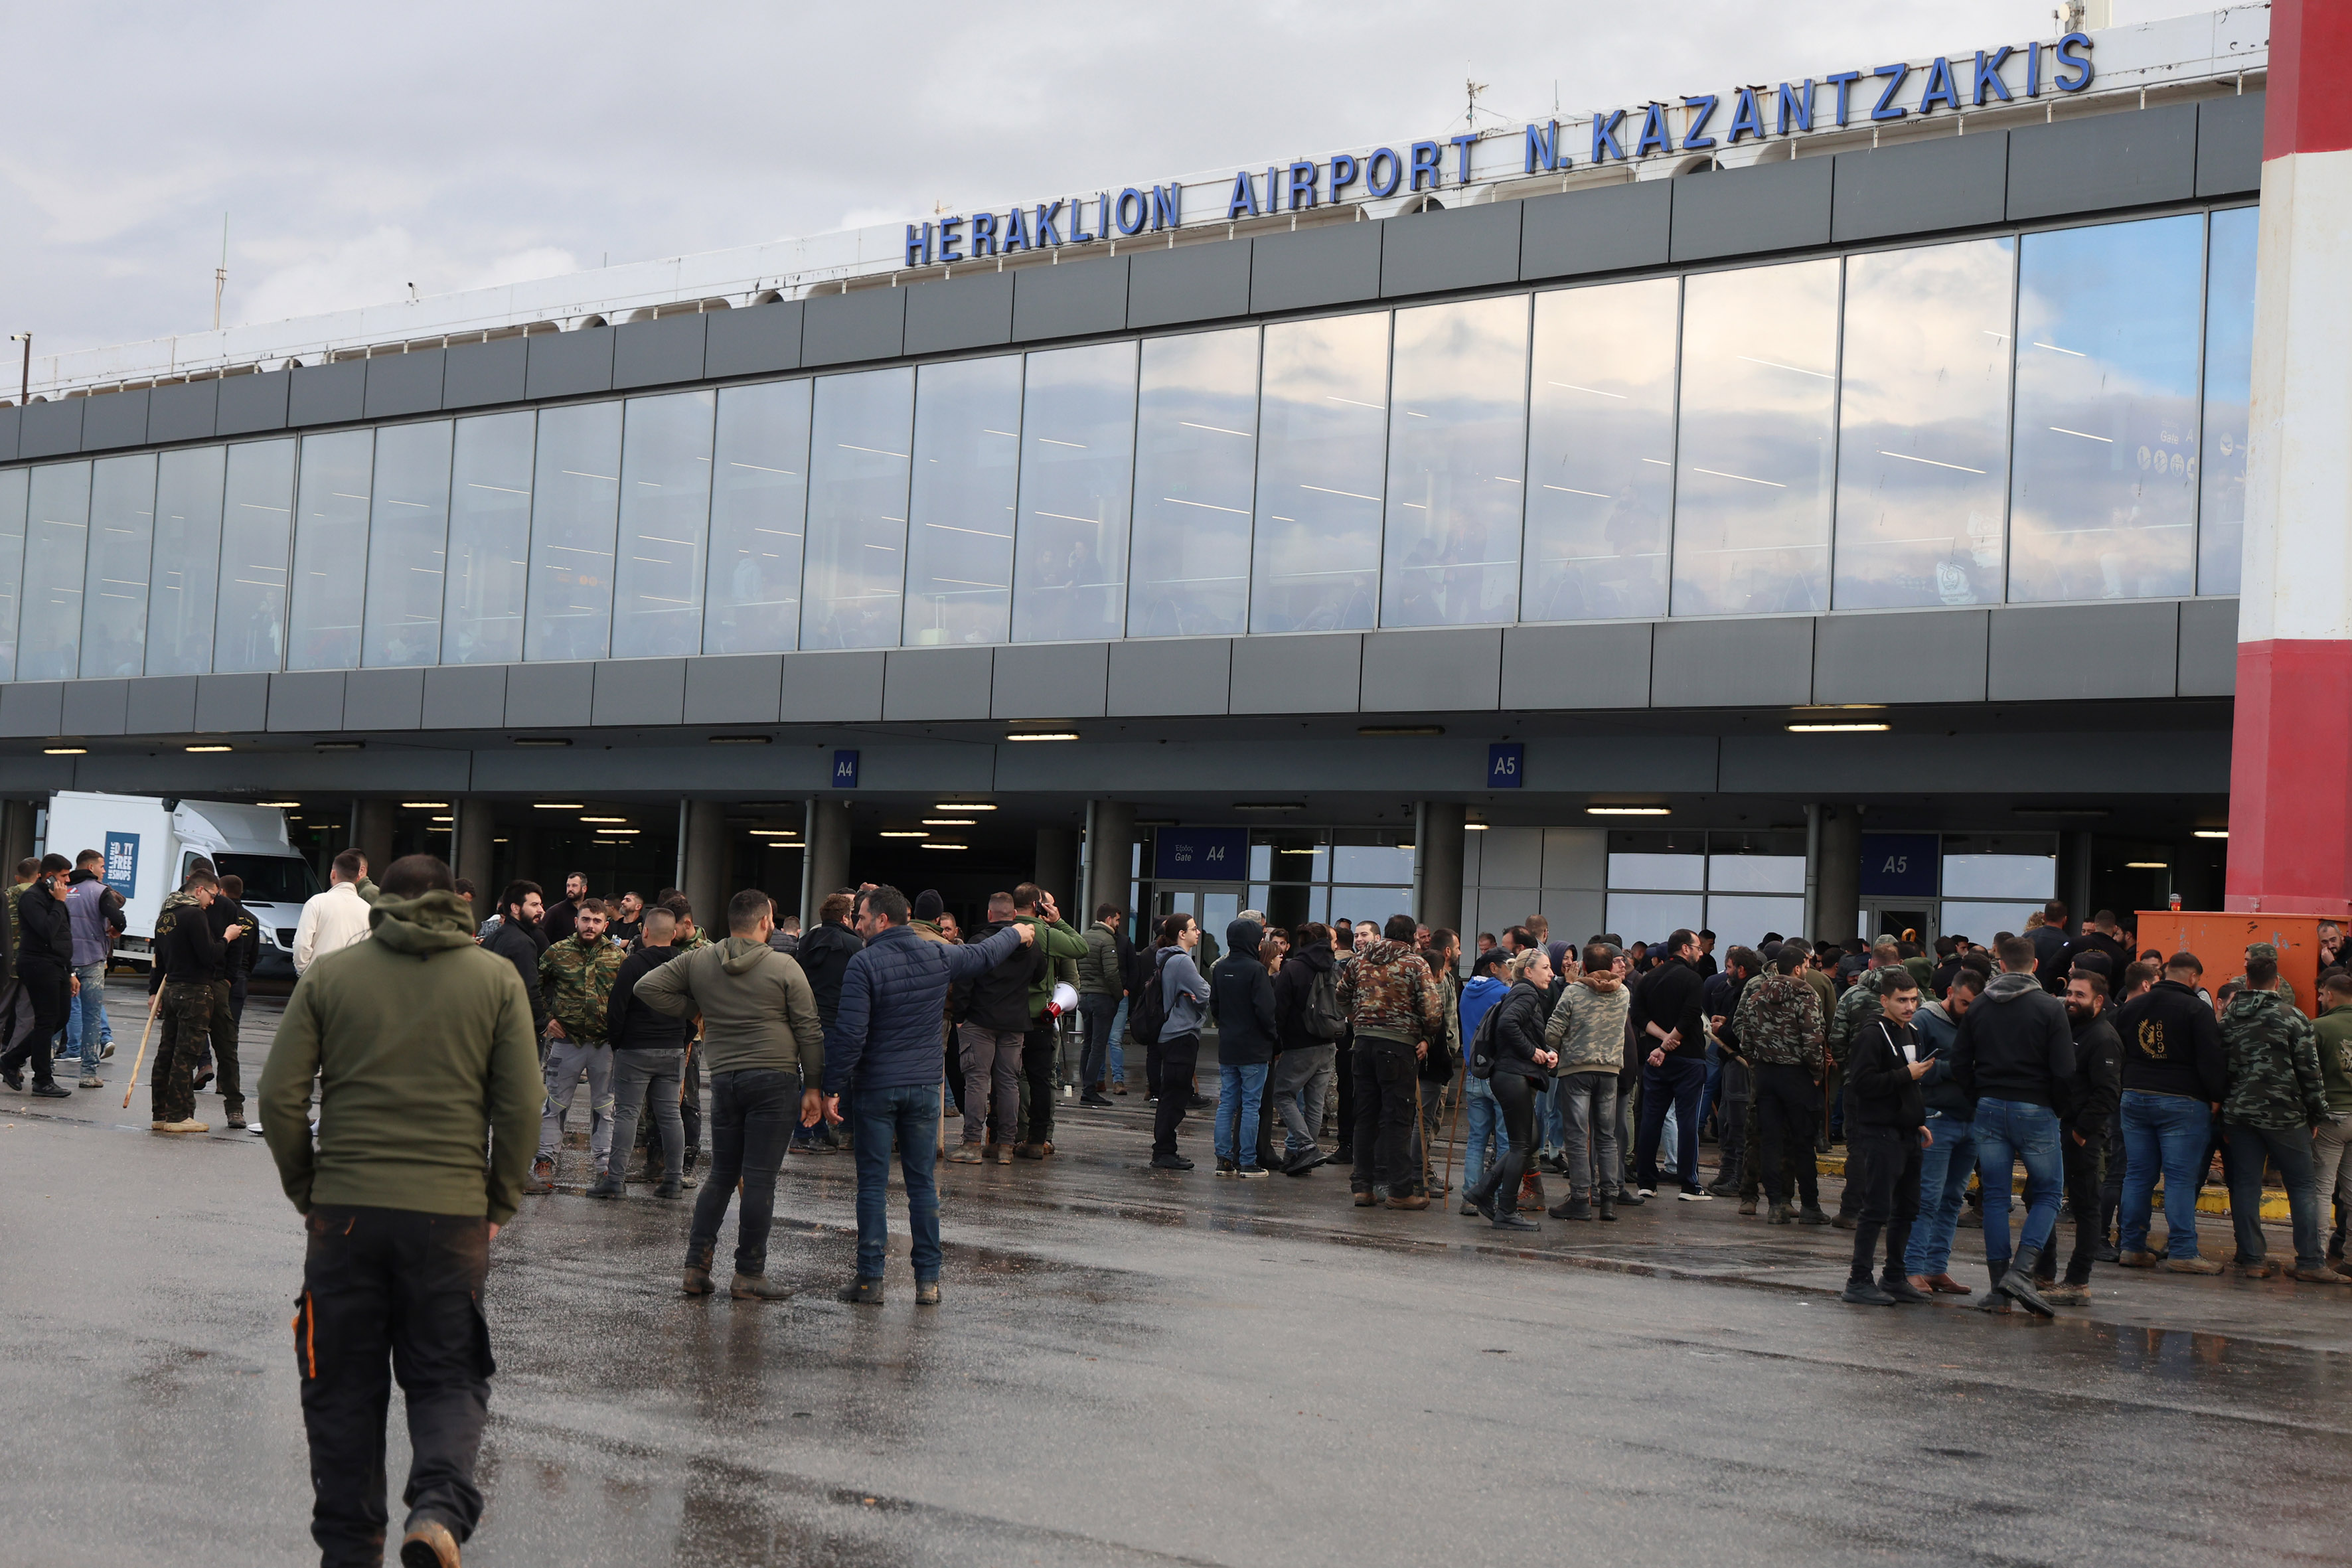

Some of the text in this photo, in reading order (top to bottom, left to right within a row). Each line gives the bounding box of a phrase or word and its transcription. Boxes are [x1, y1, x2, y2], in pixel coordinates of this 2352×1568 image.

[905, 182, 1181, 266] HERAKLION
[1227, 133, 1482, 218] AIRPORT
[2161, 430, 2179, 445] Gate
[836, 761, 852, 777] A4
[1494, 757, 1515, 775] A5
[114, 842, 134, 856] DTY
[1175, 846, 1225, 861] Gate A4
[114, 855, 132, 870] FREE
[1882, 856, 1907, 874] A5
[112, 869, 131, 882] SHOPS
